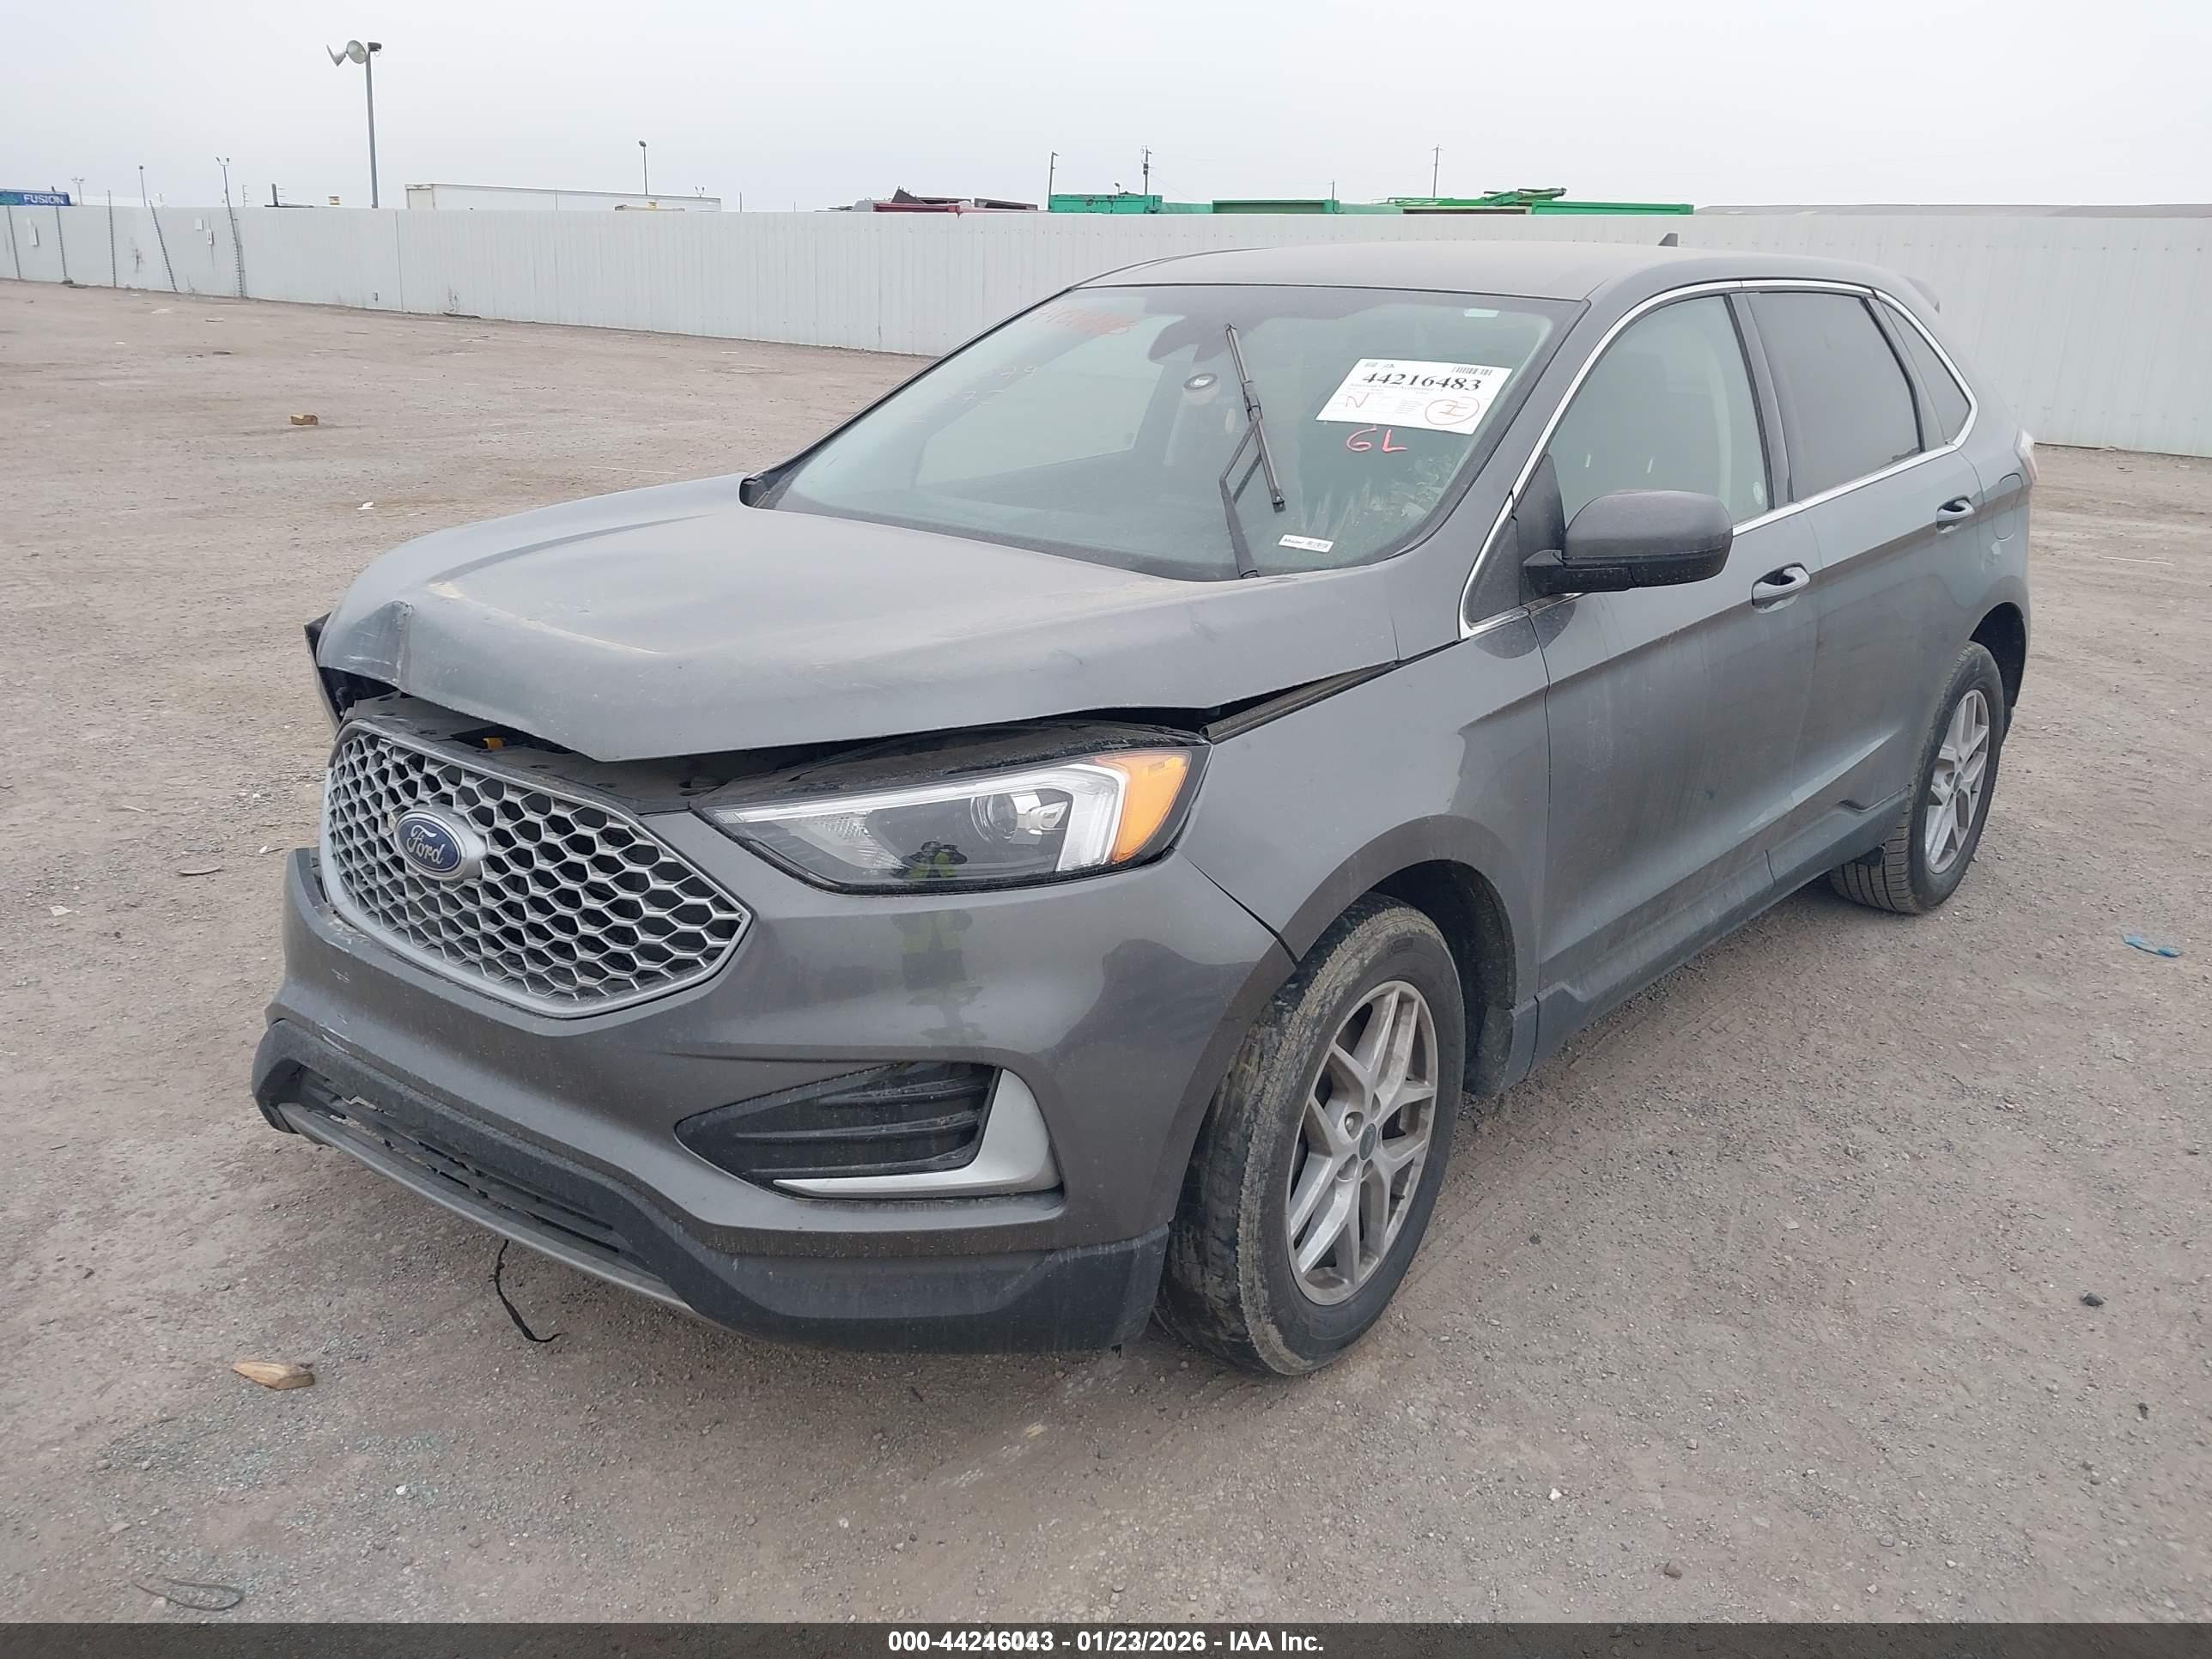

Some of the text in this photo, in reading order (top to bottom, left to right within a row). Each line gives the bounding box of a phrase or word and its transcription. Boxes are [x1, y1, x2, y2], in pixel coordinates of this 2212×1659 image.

[23, 194, 64, 204] FUSION
[1362, 372, 1482, 392] 44216483
[406, 824, 446, 864] Ford
